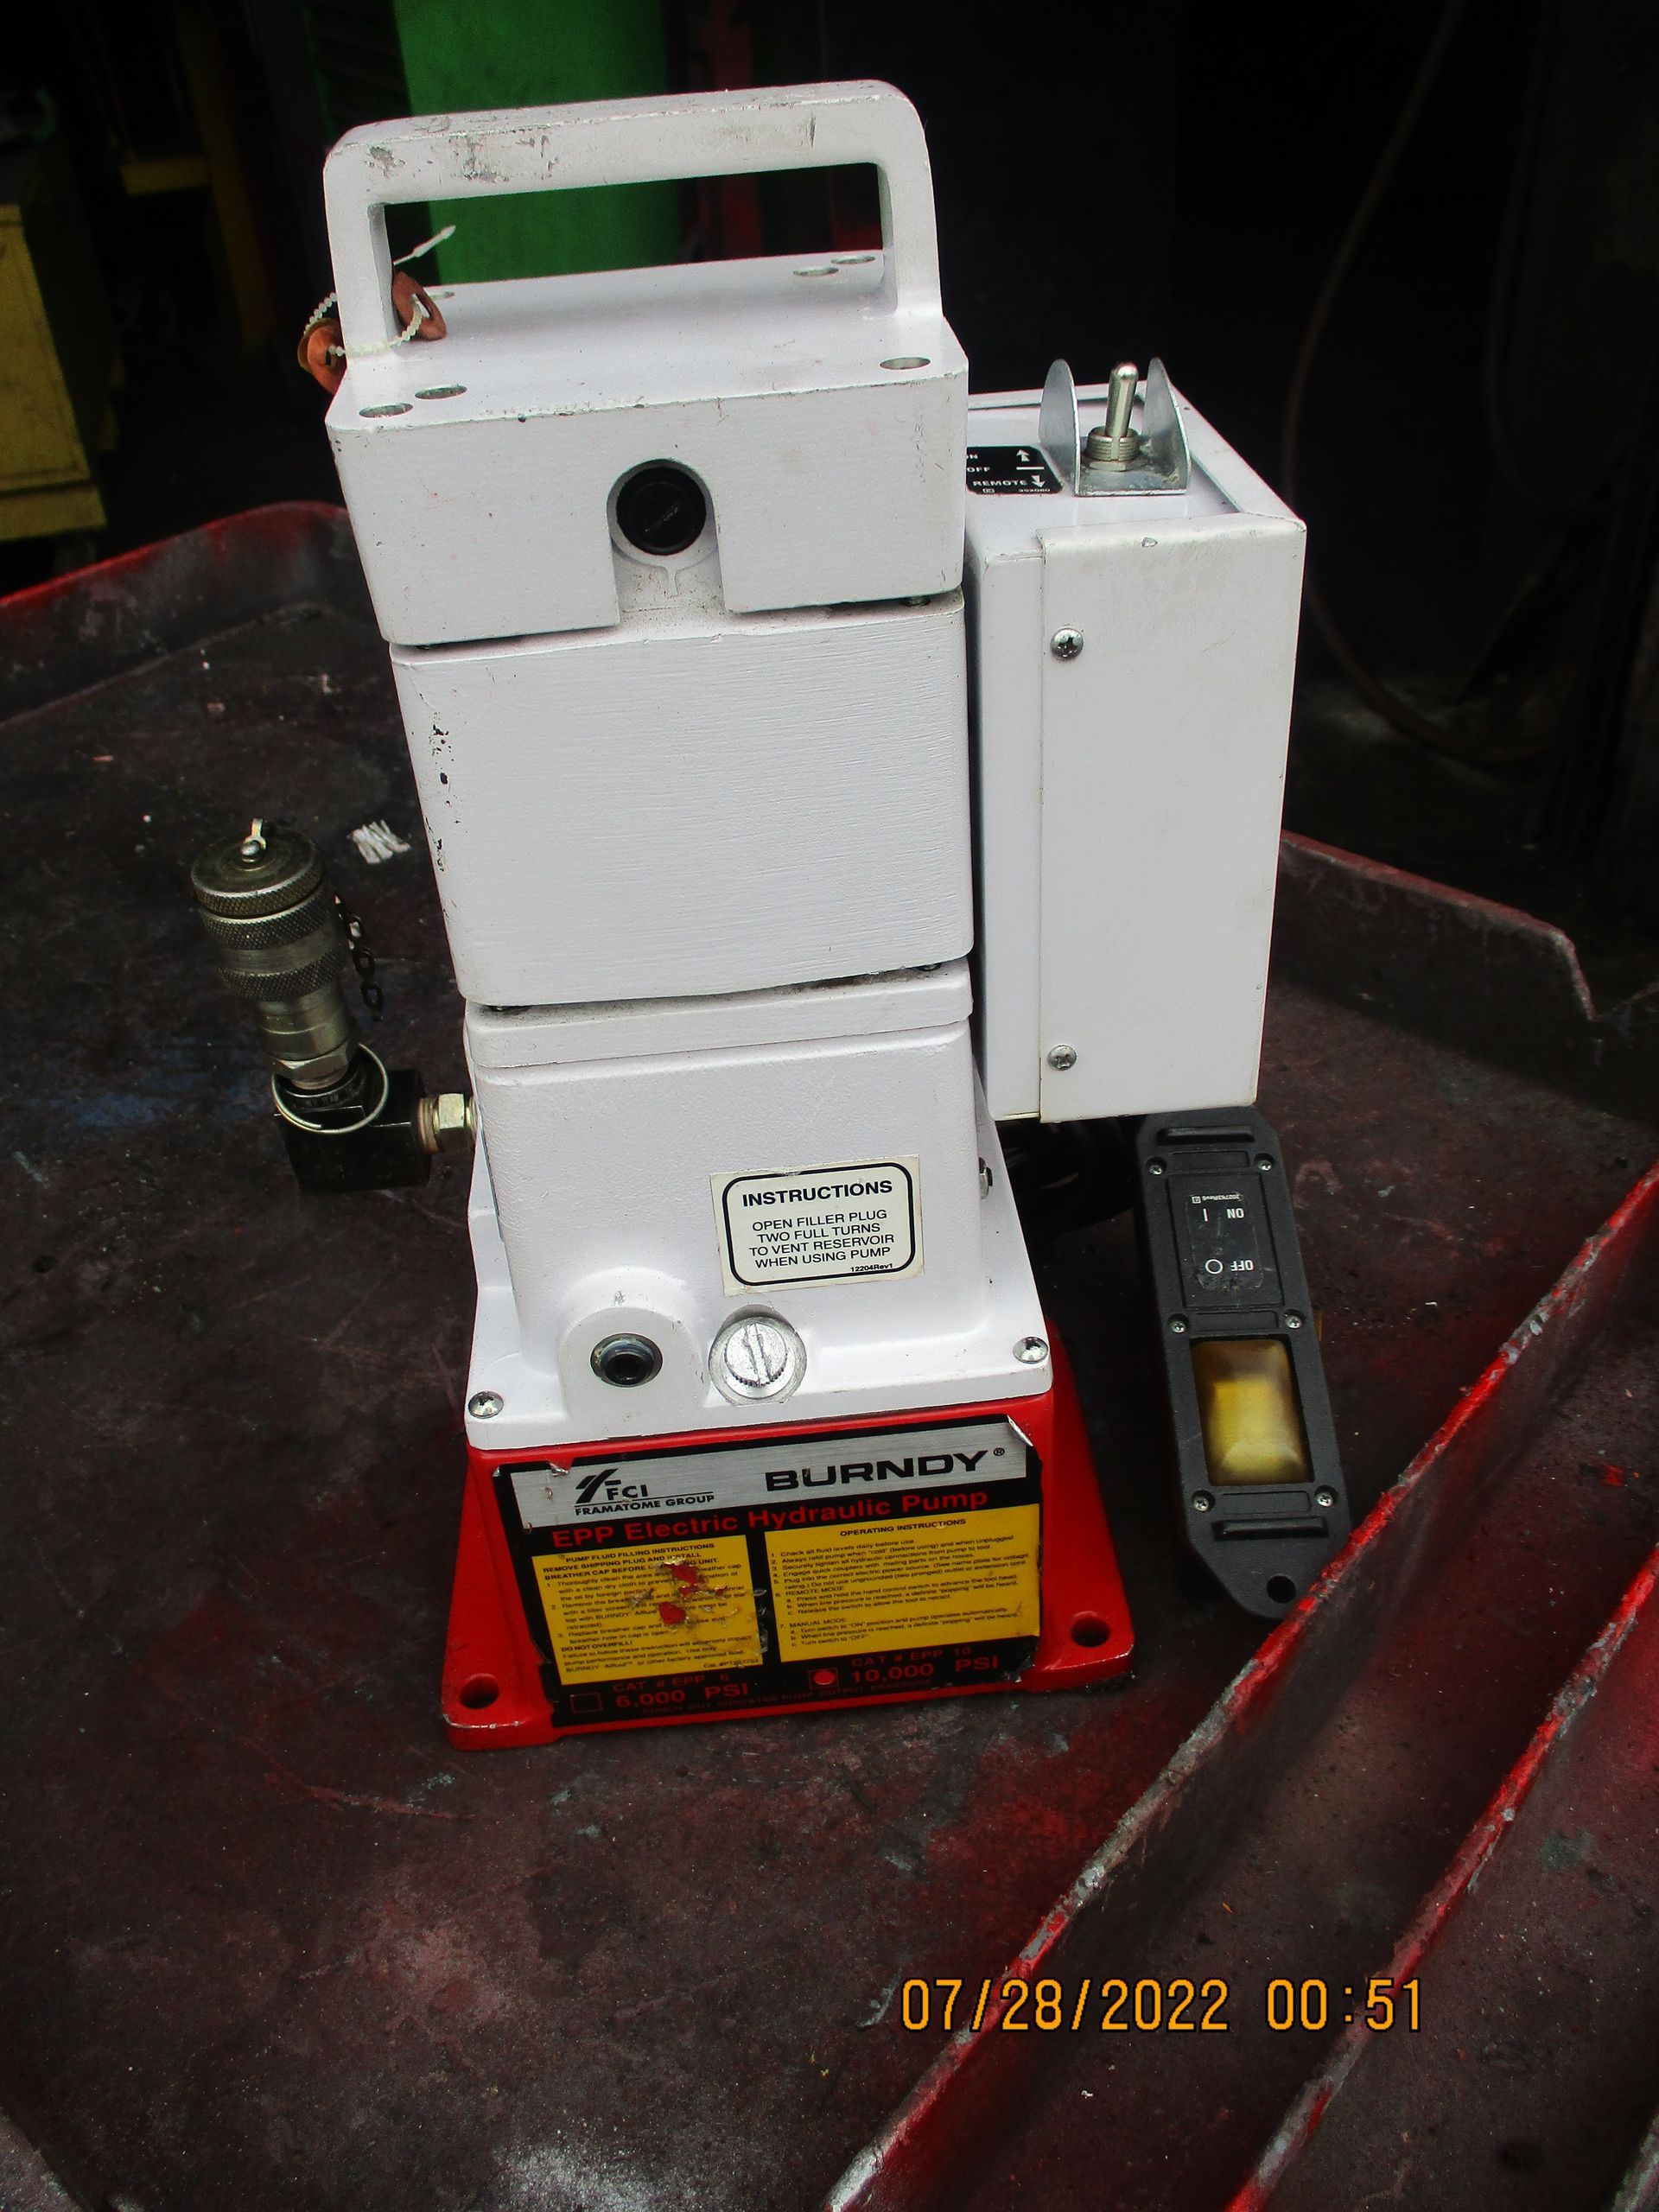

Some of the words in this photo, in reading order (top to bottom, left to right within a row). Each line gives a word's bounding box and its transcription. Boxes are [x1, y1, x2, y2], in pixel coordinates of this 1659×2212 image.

[742, 1179, 893, 1207] INSTRUCTIONS
[752, 1218, 792, 1231] OPEN
[797, 1213, 844, 1227] FILLER
[849, 1210, 887, 1222] PLUG
[1226, 1207, 1244, 1219] ON
[757, 1231, 790, 1243] TWO
[794, 1228, 829, 1240] FULL
[831, 1223, 880, 1236] TURNS
[749, 1246, 768, 1257] TO
[771, 1242, 810, 1255] VENT
[813, 1234, 894, 1251] RESERVOIR
[755, 1255, 798, 1268] WHEN
[802, 1251, 846, 1264] USING
[850, 1247, 891, 1259] PUMP
[1230, 1259, 1255, 1272] OFF
[850, 1263, 893, 1273] 12204Rev1
[607, 1484, 649, 1501] FCI
[575, 1500, 661, 1516] FRAMATOME
[665, 1495, 715, 1507] GROUP
[552, 1526, 614, 1548] EPP
[623, 1514, 738, 1541] Electric
[747, 1499, 891, 1529] Hydraulic
[901, 1491, 988, 1512] Pump
[840, 1525, 894, 1536] OPERATING
[896, 1518, 966, 1530] INSTRUCTIONS
[652, 1543, 715, 1554] INSTRUCTIONS
[542, 1564, 579, 1573] REMOVE
[580, 1560, 620, 1568] SHIPPING
[543, 1571, 590, 1580] BREATHER
[851, 1656, 887, 1668] CAT
[909, 1649, 945, 1661] EPP
[953, 1646, 972, 1656] 10
[954, 1655, 1001, 1673] PSI
[613, 1681, 647, 1693] CAT
[671, 1675, 706, 1687] EPP
[719, 1672, 730, 1681] 6
[704, 1682, 748, 1699] PSI
